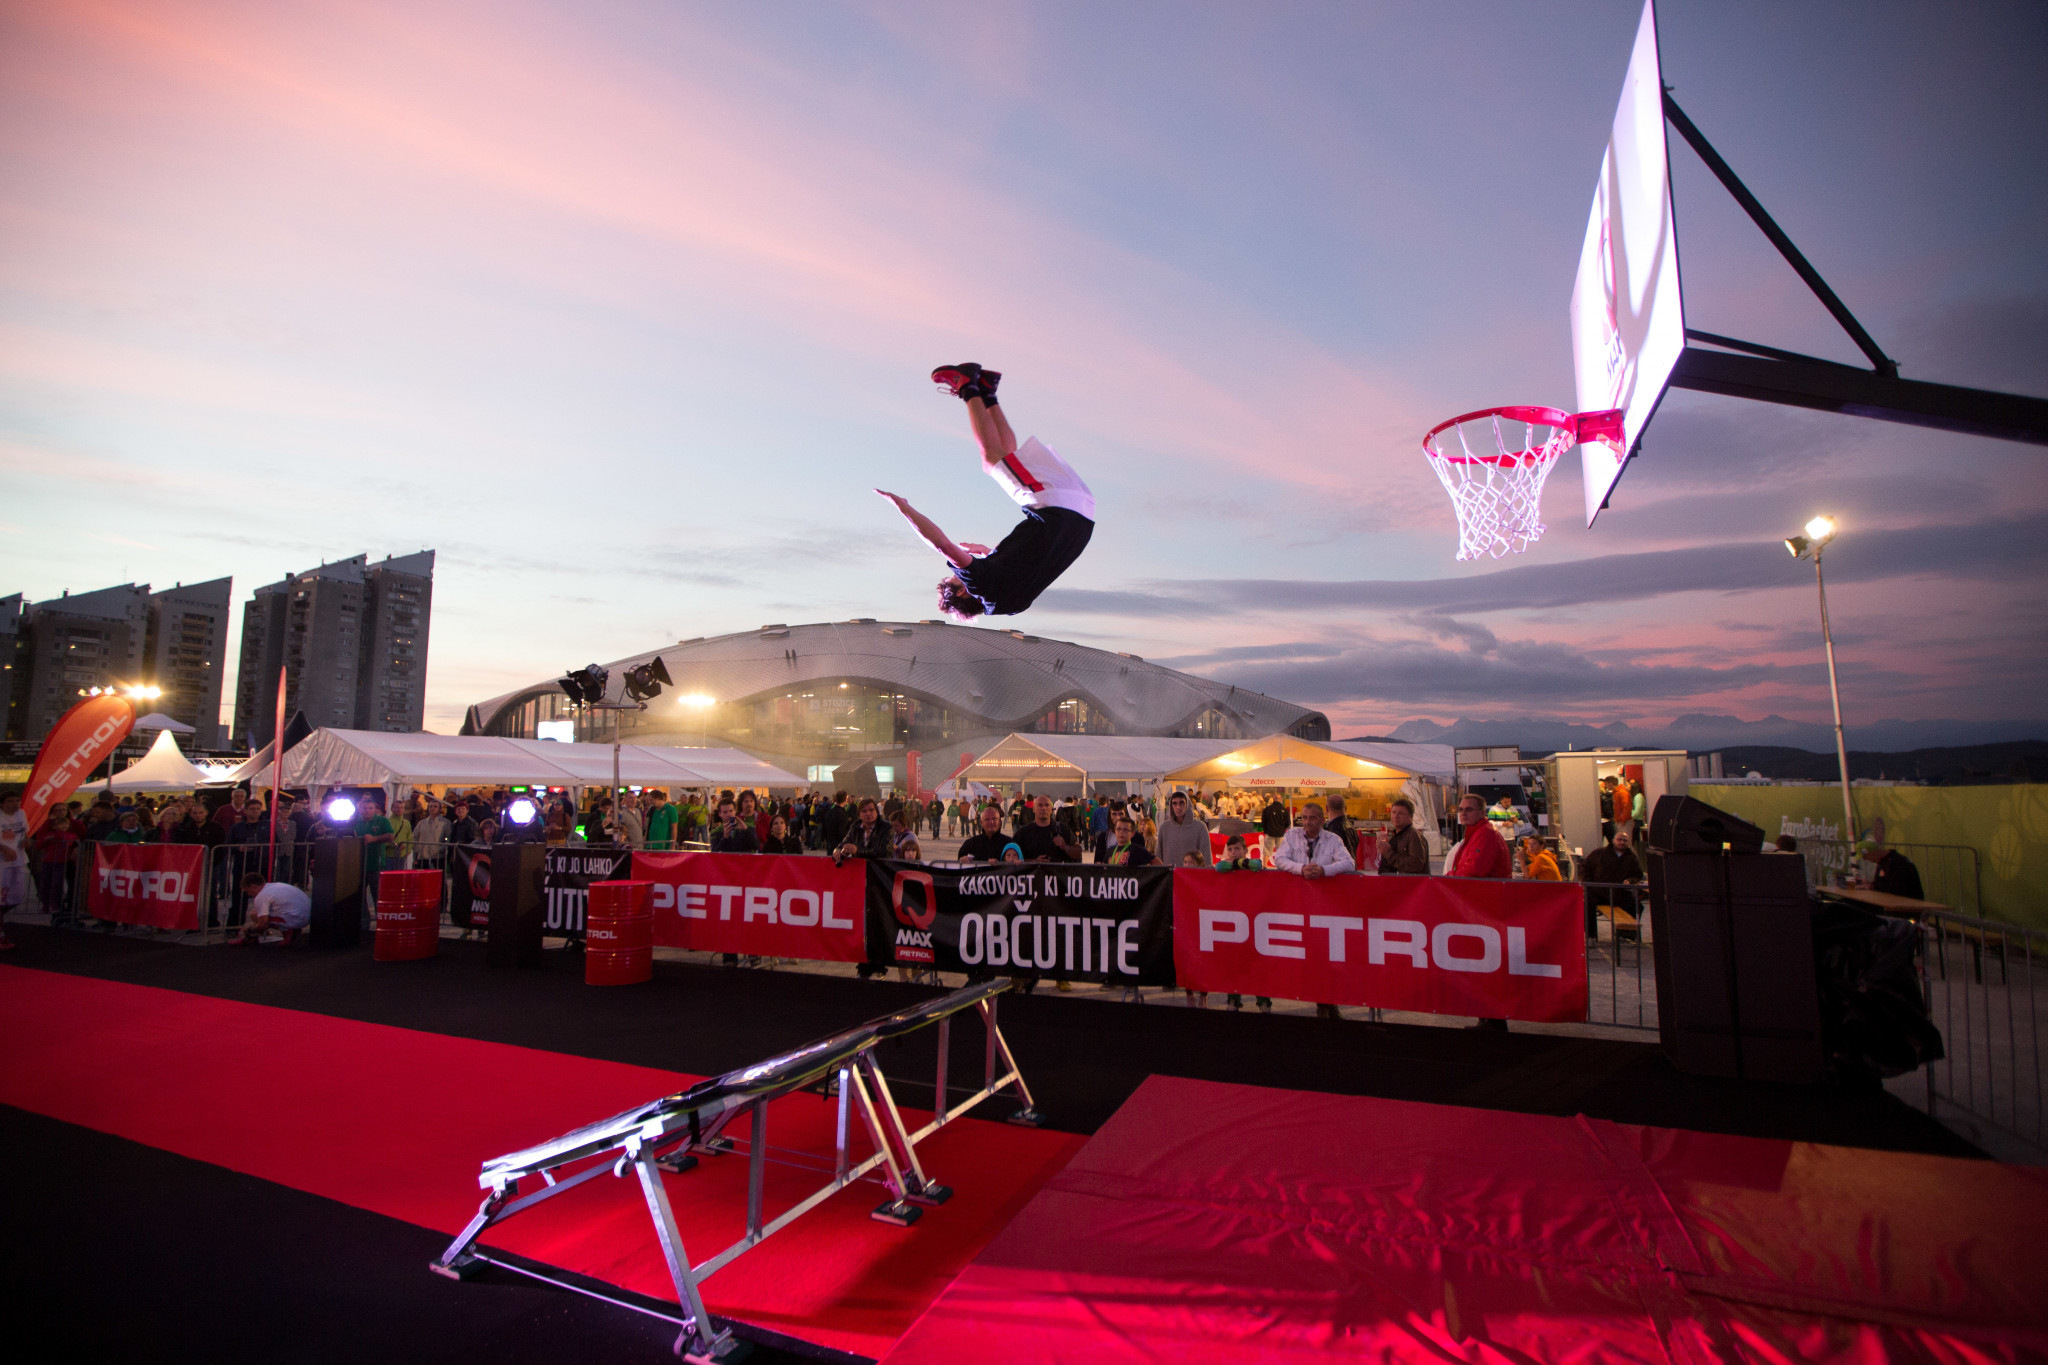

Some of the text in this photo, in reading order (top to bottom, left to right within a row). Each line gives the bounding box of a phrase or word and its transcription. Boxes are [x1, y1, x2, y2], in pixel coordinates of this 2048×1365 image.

[32, 713, 129, 807] PETROL
[1780, 815, 1840, 841] EuroBasket
[583, 857, 613, 875] LAHKO
[98, 867, 195, 902] PETROL
[958, 874, 1139, 900] KAKOVOST, KI JO LAHKO
[377, 912, 416, 920] ETROL
[653, 882, 853, 930] PETROL
[895, 929, 933, 948] MAX
[959, 900, 1140, 975] OBČUTITE
[1198, 908, 1562, 979] PETROL
[899, 950, 932, 960] PETROL
